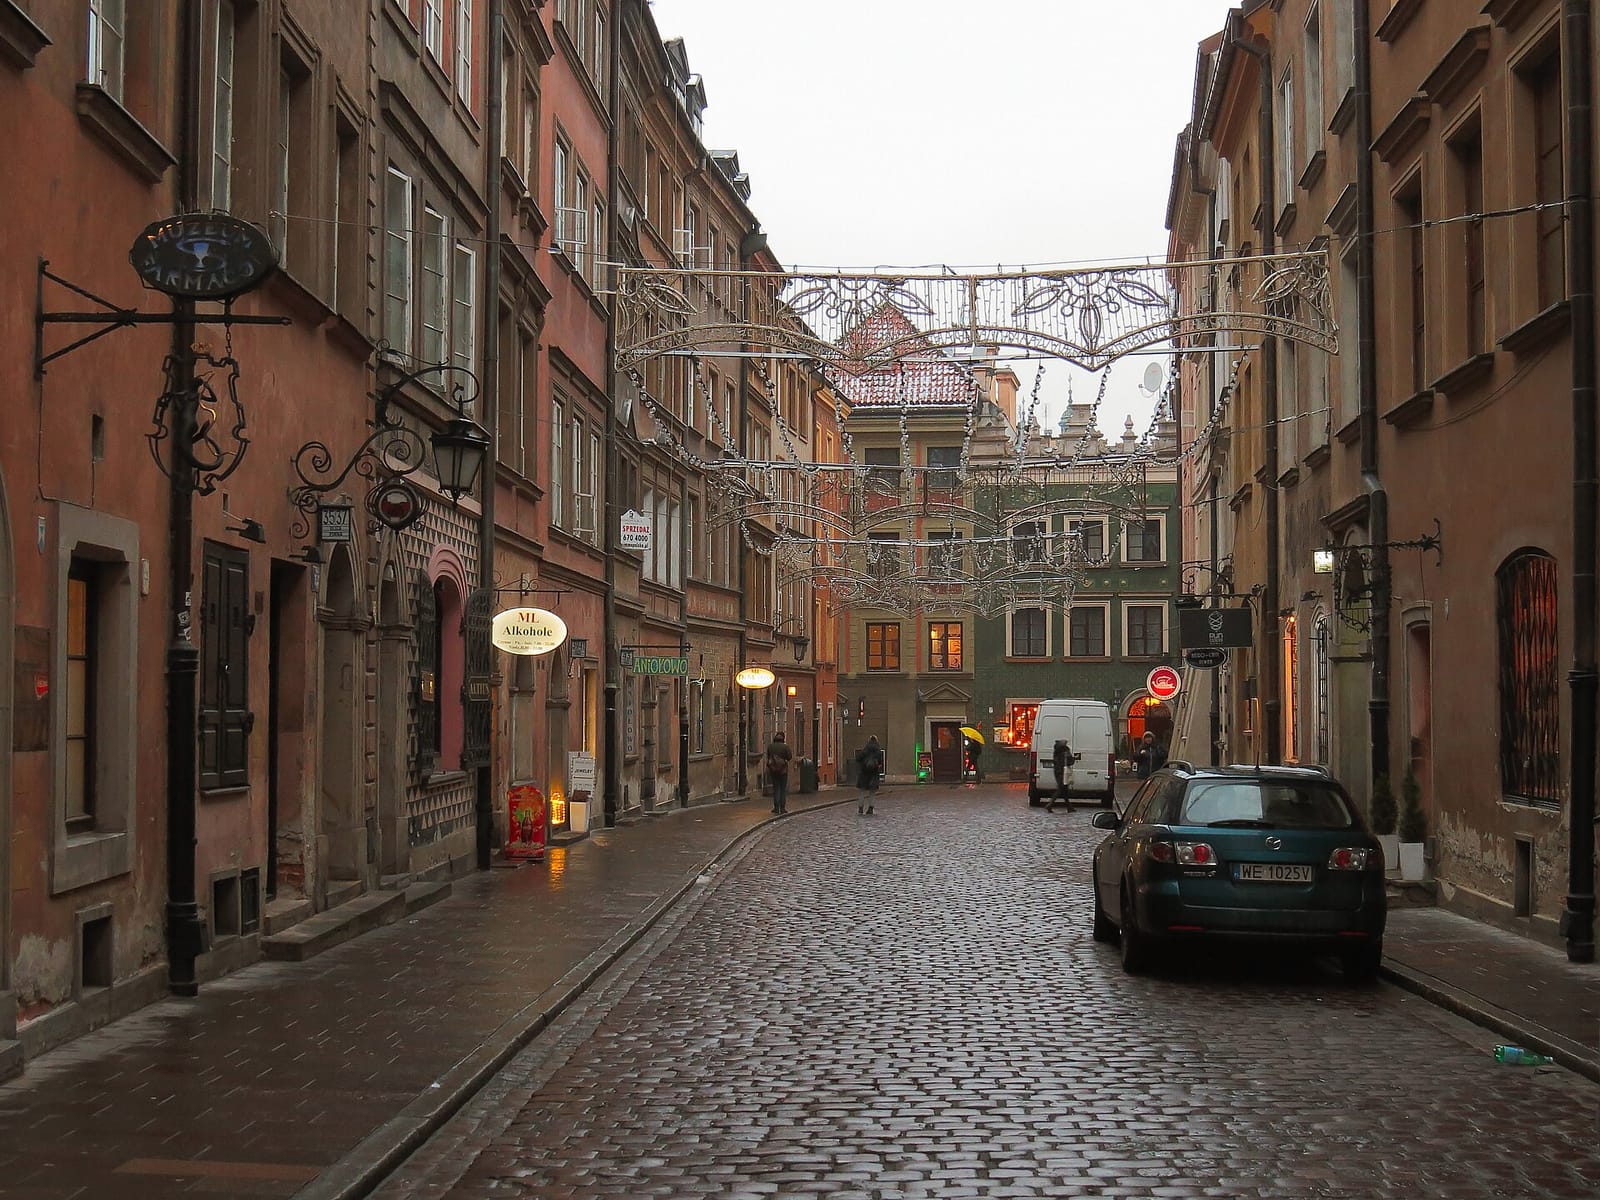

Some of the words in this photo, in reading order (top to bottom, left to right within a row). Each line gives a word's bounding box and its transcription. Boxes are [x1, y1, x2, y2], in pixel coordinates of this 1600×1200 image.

[518, 612, 540, 623] ML
[503, 625, 553, 637] Alkohole
[1242, 864, 1263, 879] WE
[1268, 865, 1310, 881] 1025V
